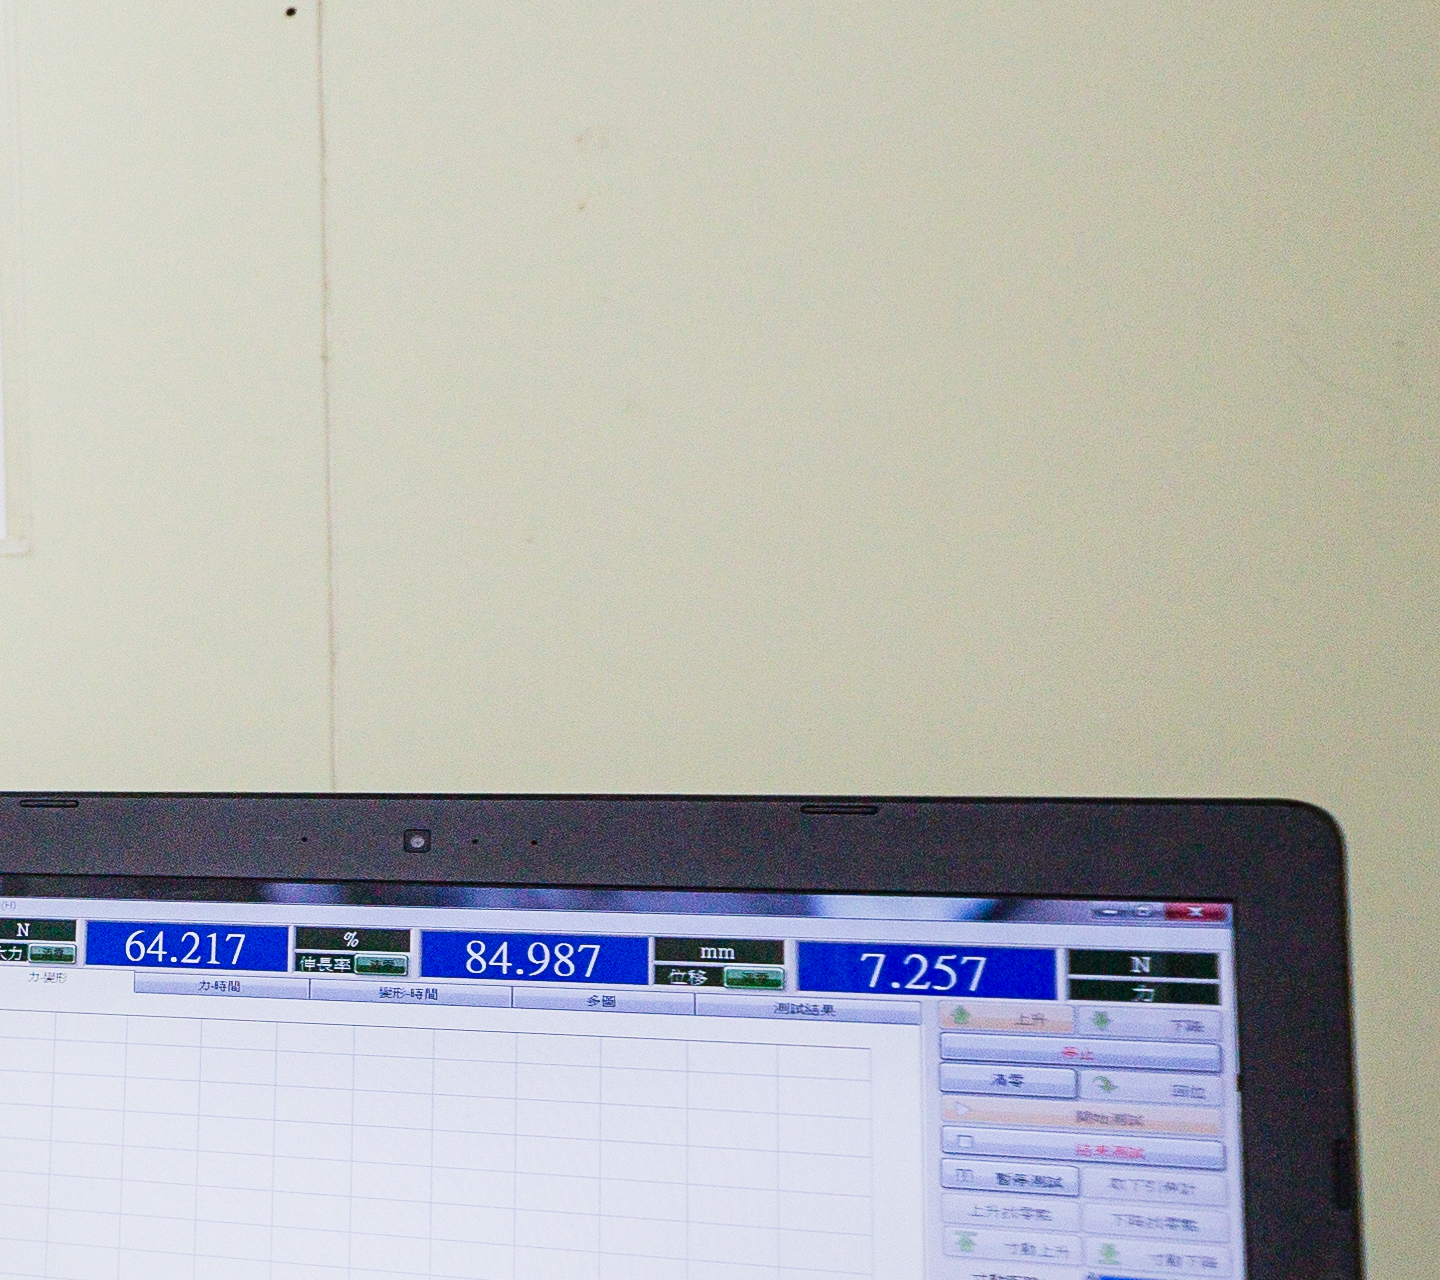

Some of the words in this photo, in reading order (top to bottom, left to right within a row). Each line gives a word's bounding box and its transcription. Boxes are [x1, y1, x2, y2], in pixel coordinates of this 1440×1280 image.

[16, 923, 30, 937] N
[125, 929, 246, 965] 64.217
[465, 940, 601, 978] 84.987
[700, 945, 735, 960] mm
[861, 952, 987, 992] 7.257
[1129, 956, 1151, 974] N
